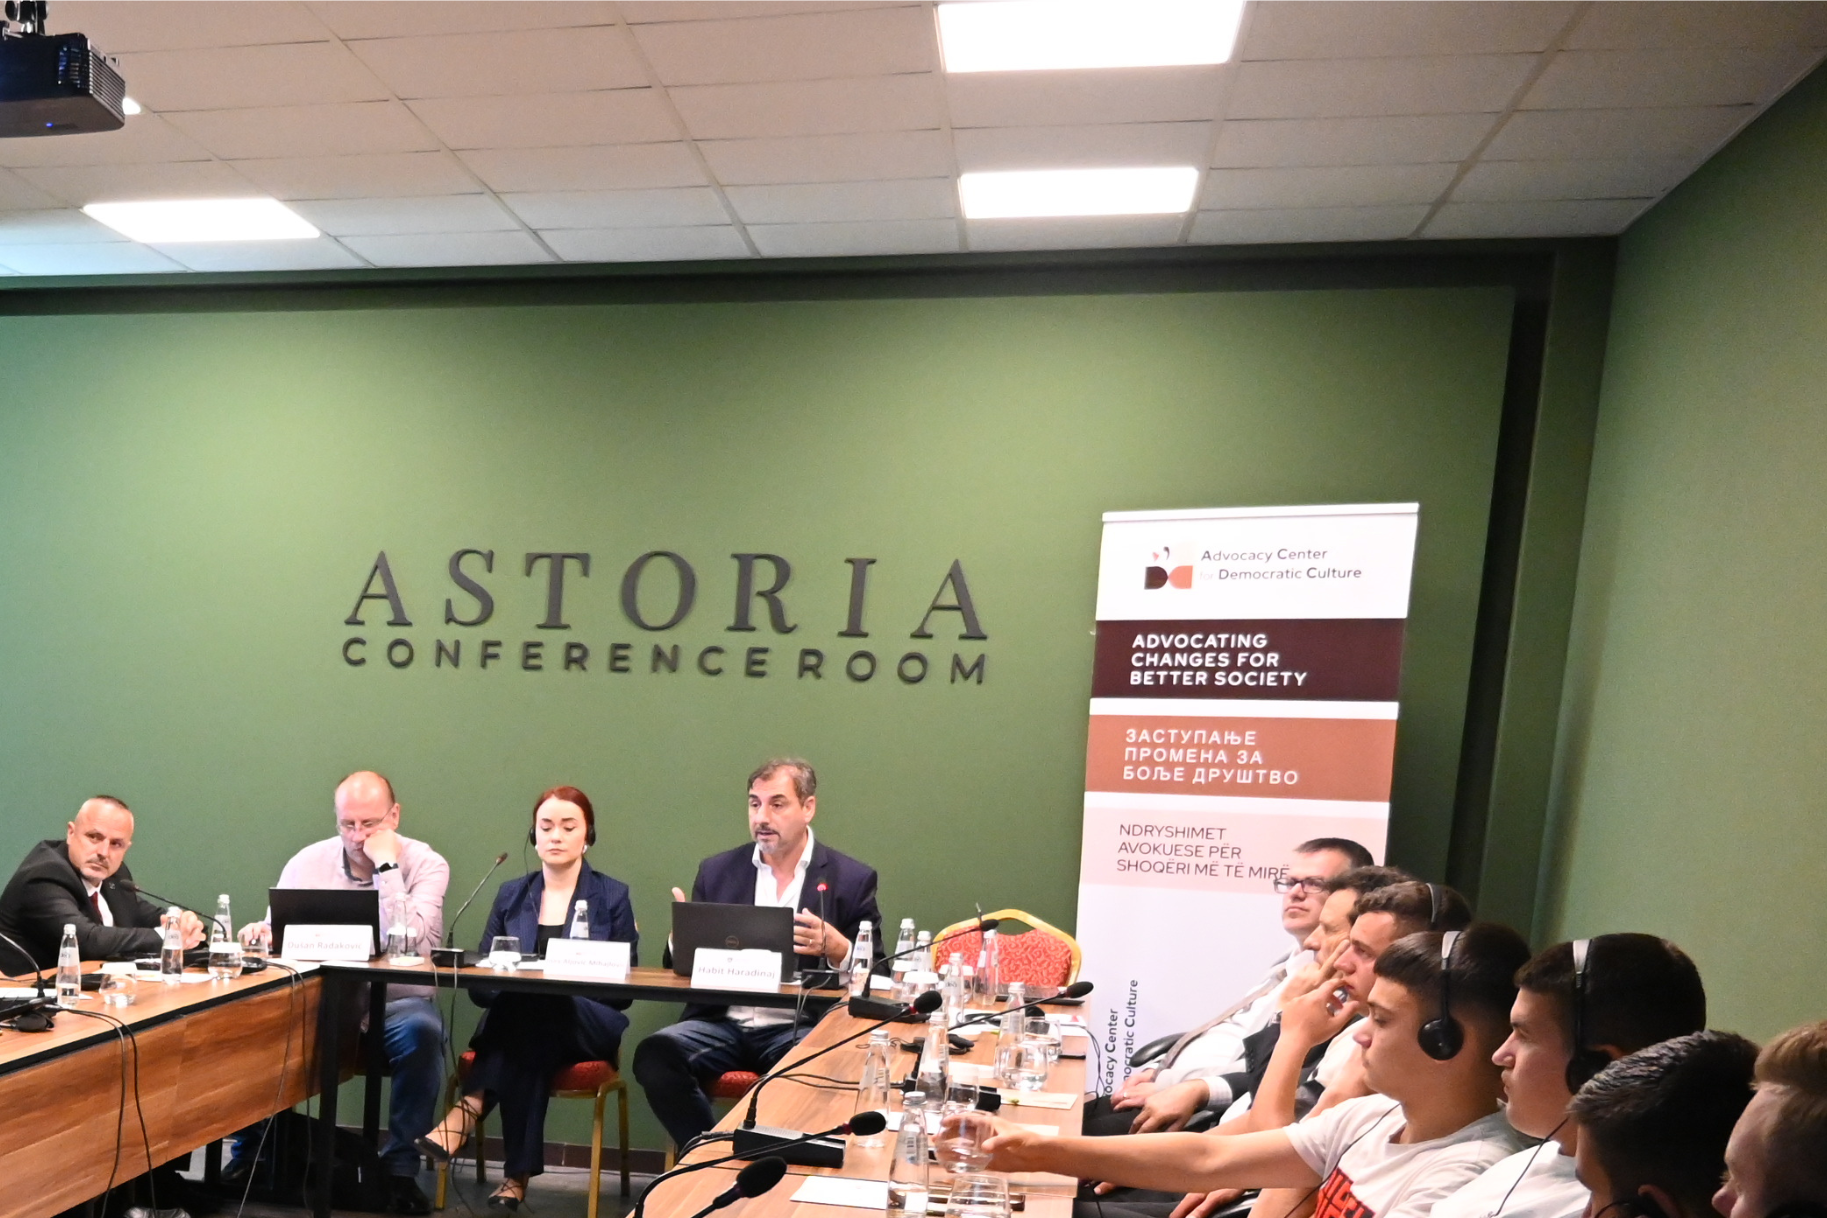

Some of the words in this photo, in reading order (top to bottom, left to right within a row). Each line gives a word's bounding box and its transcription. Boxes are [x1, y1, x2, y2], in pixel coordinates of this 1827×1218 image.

[1200, 549, 1273, 564] Advocacy
[1277, 548, 1328, 561] Center
[1218, 568, 1302, 580] Democratic
[1306, 566, 1362, 579] Culture
[344, 548, 988, 640] ASTORIA
[1131, 633, 1268, 649] ADVOCATING
[1130, 652, 1231, 667] CHANGES
[1236, 653, 1280, 667] FOR
[1129, 670, 1208, 686] BETTER
[1214, 671, 1308, 686] SOCIETY
[1125, 729, 1257, 746] ЗАСТУПАЊЕ
[1124, 747, 1228, 764] ПРОМЕНА
[1236, 750, 1264, 765] ЗА
[1123, 766, 1185, 782] БОЉЕ
[1192, 767, 1300, 785] ДРУШТВО
[1119, 823, 1227, 840] NDRYSHIMET
[1118, 842, 1205, 858] AVOKUESE
[1208, 843, 1242, 860] PËR
[1117, 858, 1191, 876] SHOQËRI
[1194, 860, 1219, 877] MË
[1224, 862, 1245, 878] TË
[1248, 864, 1291, 880] MIRË
[1124, 979, 1138, 1028] Culture
[1104, 1008, 1119, 1053] Center
[1123, 1031, 1135, 1081] ocratic
[1104, 1056, 1119, 1097] ocacy
